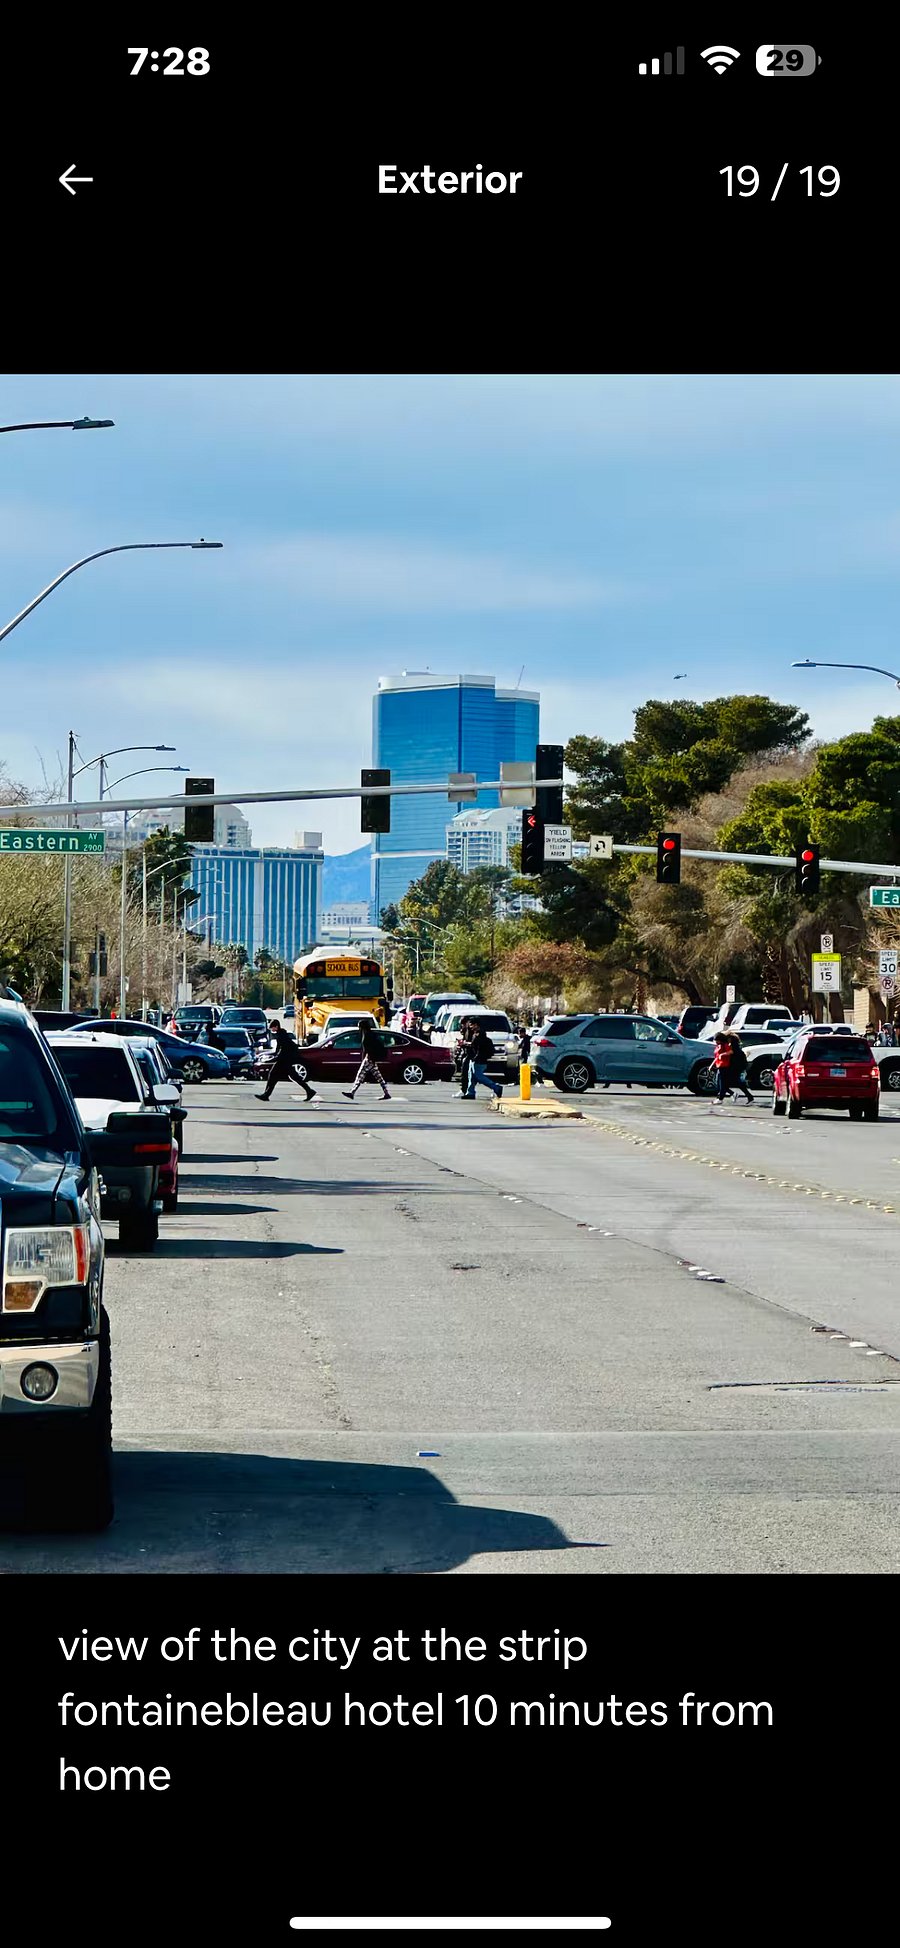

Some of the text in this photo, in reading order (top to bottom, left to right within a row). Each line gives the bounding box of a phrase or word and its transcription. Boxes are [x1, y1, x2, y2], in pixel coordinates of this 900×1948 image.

[0, 832, 79, 850] Eastern
[83, 844, 102, 852] 2900
[327, 963, 359, 972] SCHOOL BUS
[880, 963, 896, 973] 30
[820, 972, 833, 981] 15
